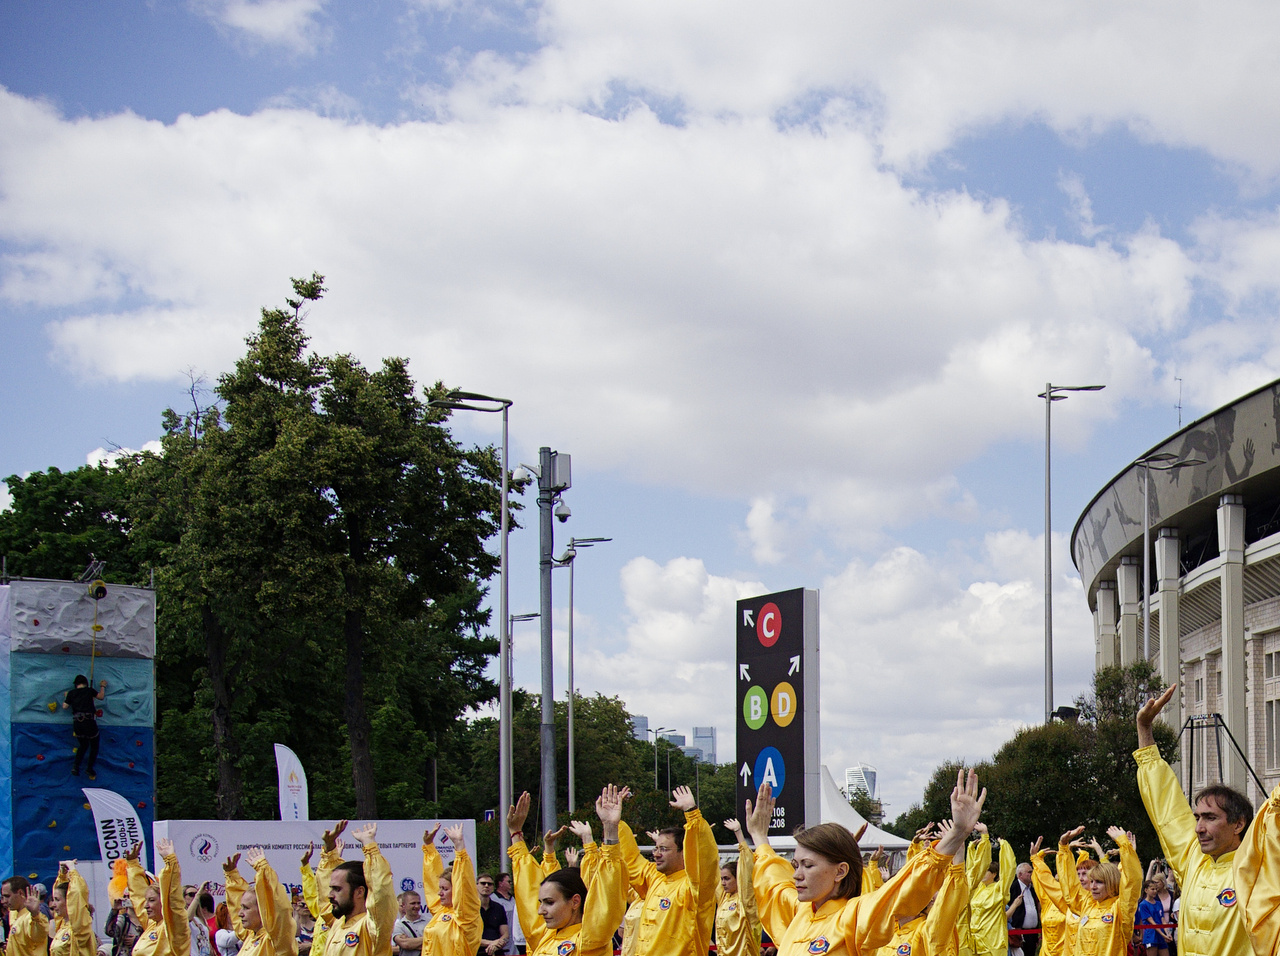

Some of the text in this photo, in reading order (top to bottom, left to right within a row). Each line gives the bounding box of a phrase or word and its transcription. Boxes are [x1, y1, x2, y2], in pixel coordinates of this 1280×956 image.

[762, 613, 774, 638] C
[750, 692, 790, 721] B D
[762, 757, 778, 787] A
